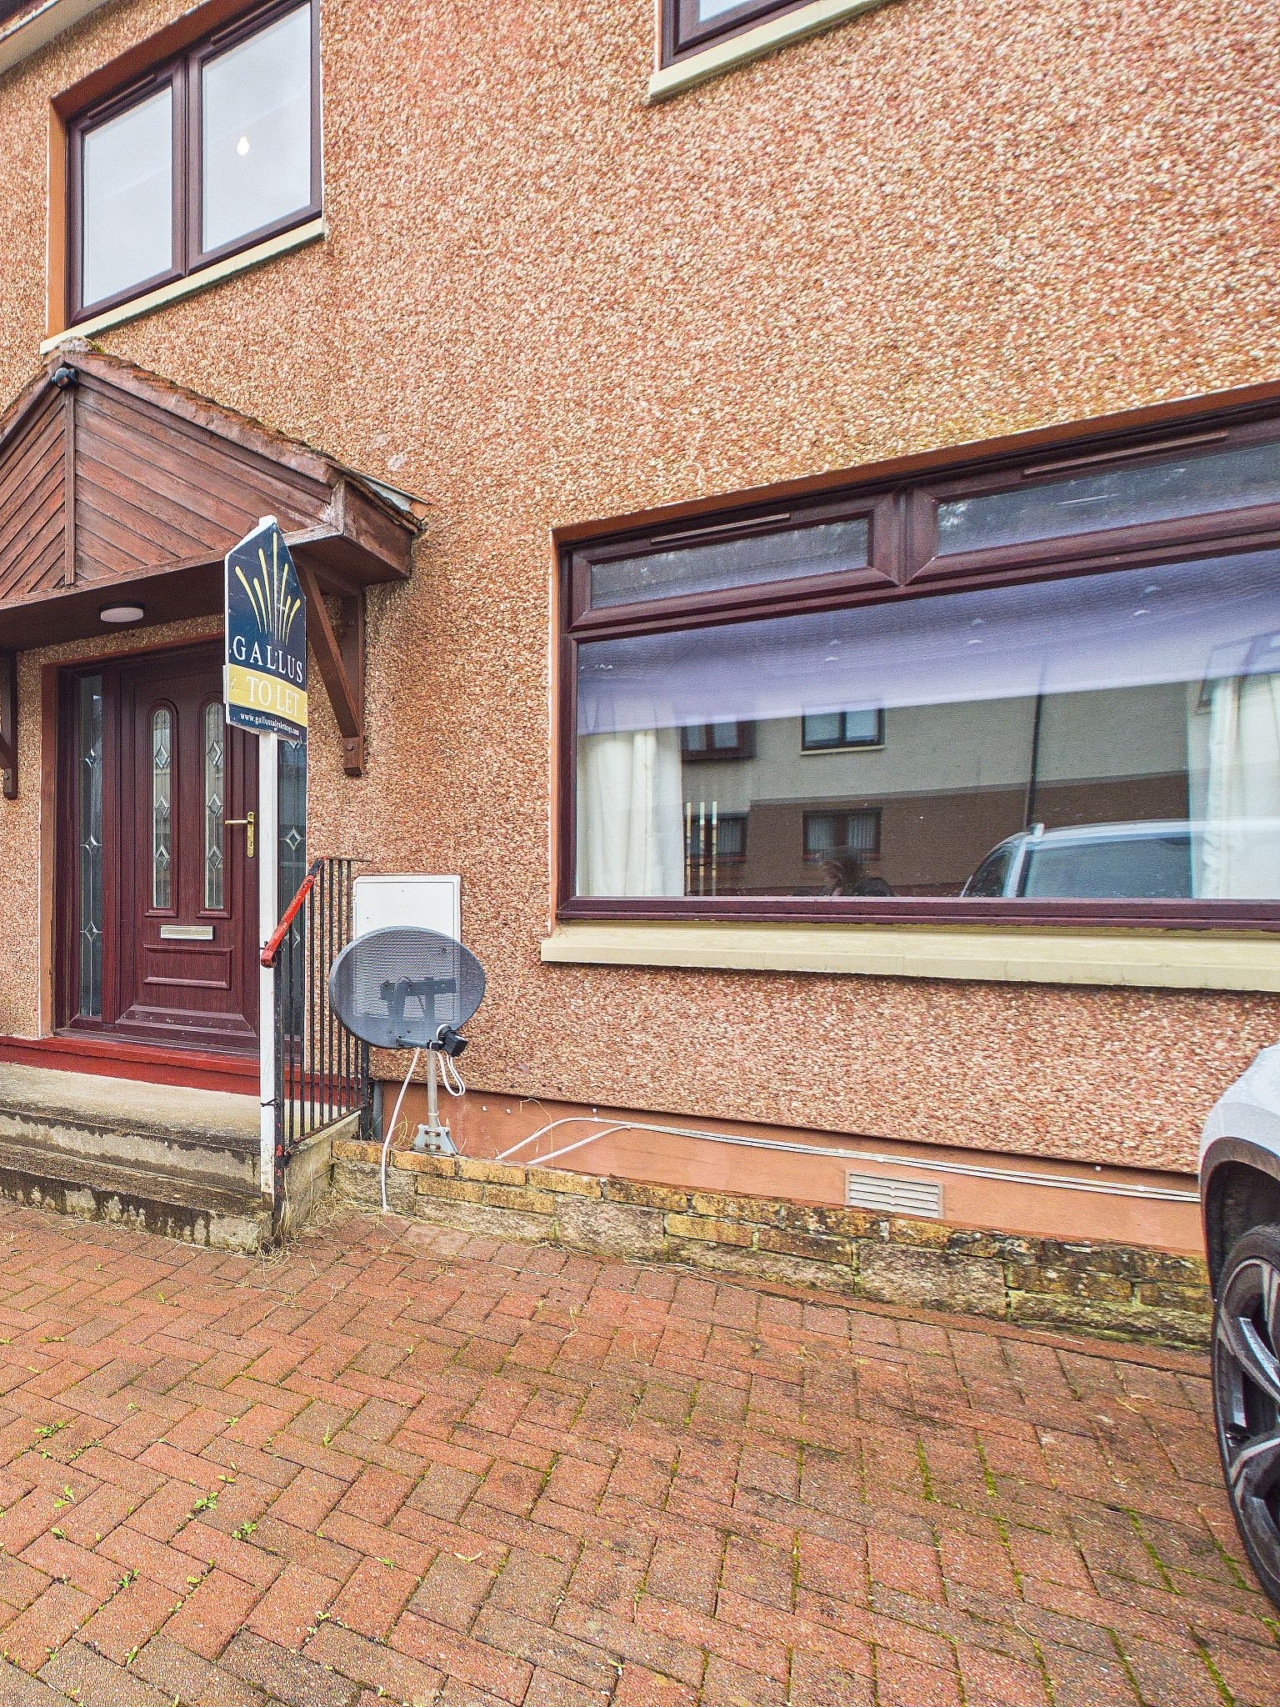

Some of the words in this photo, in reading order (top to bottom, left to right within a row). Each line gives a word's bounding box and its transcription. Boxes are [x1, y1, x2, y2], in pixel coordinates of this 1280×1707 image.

[232, 635, 303, 683] GALLUS
[246, 675, 272, 706] TO
[276, 684, 299, 718] LET
